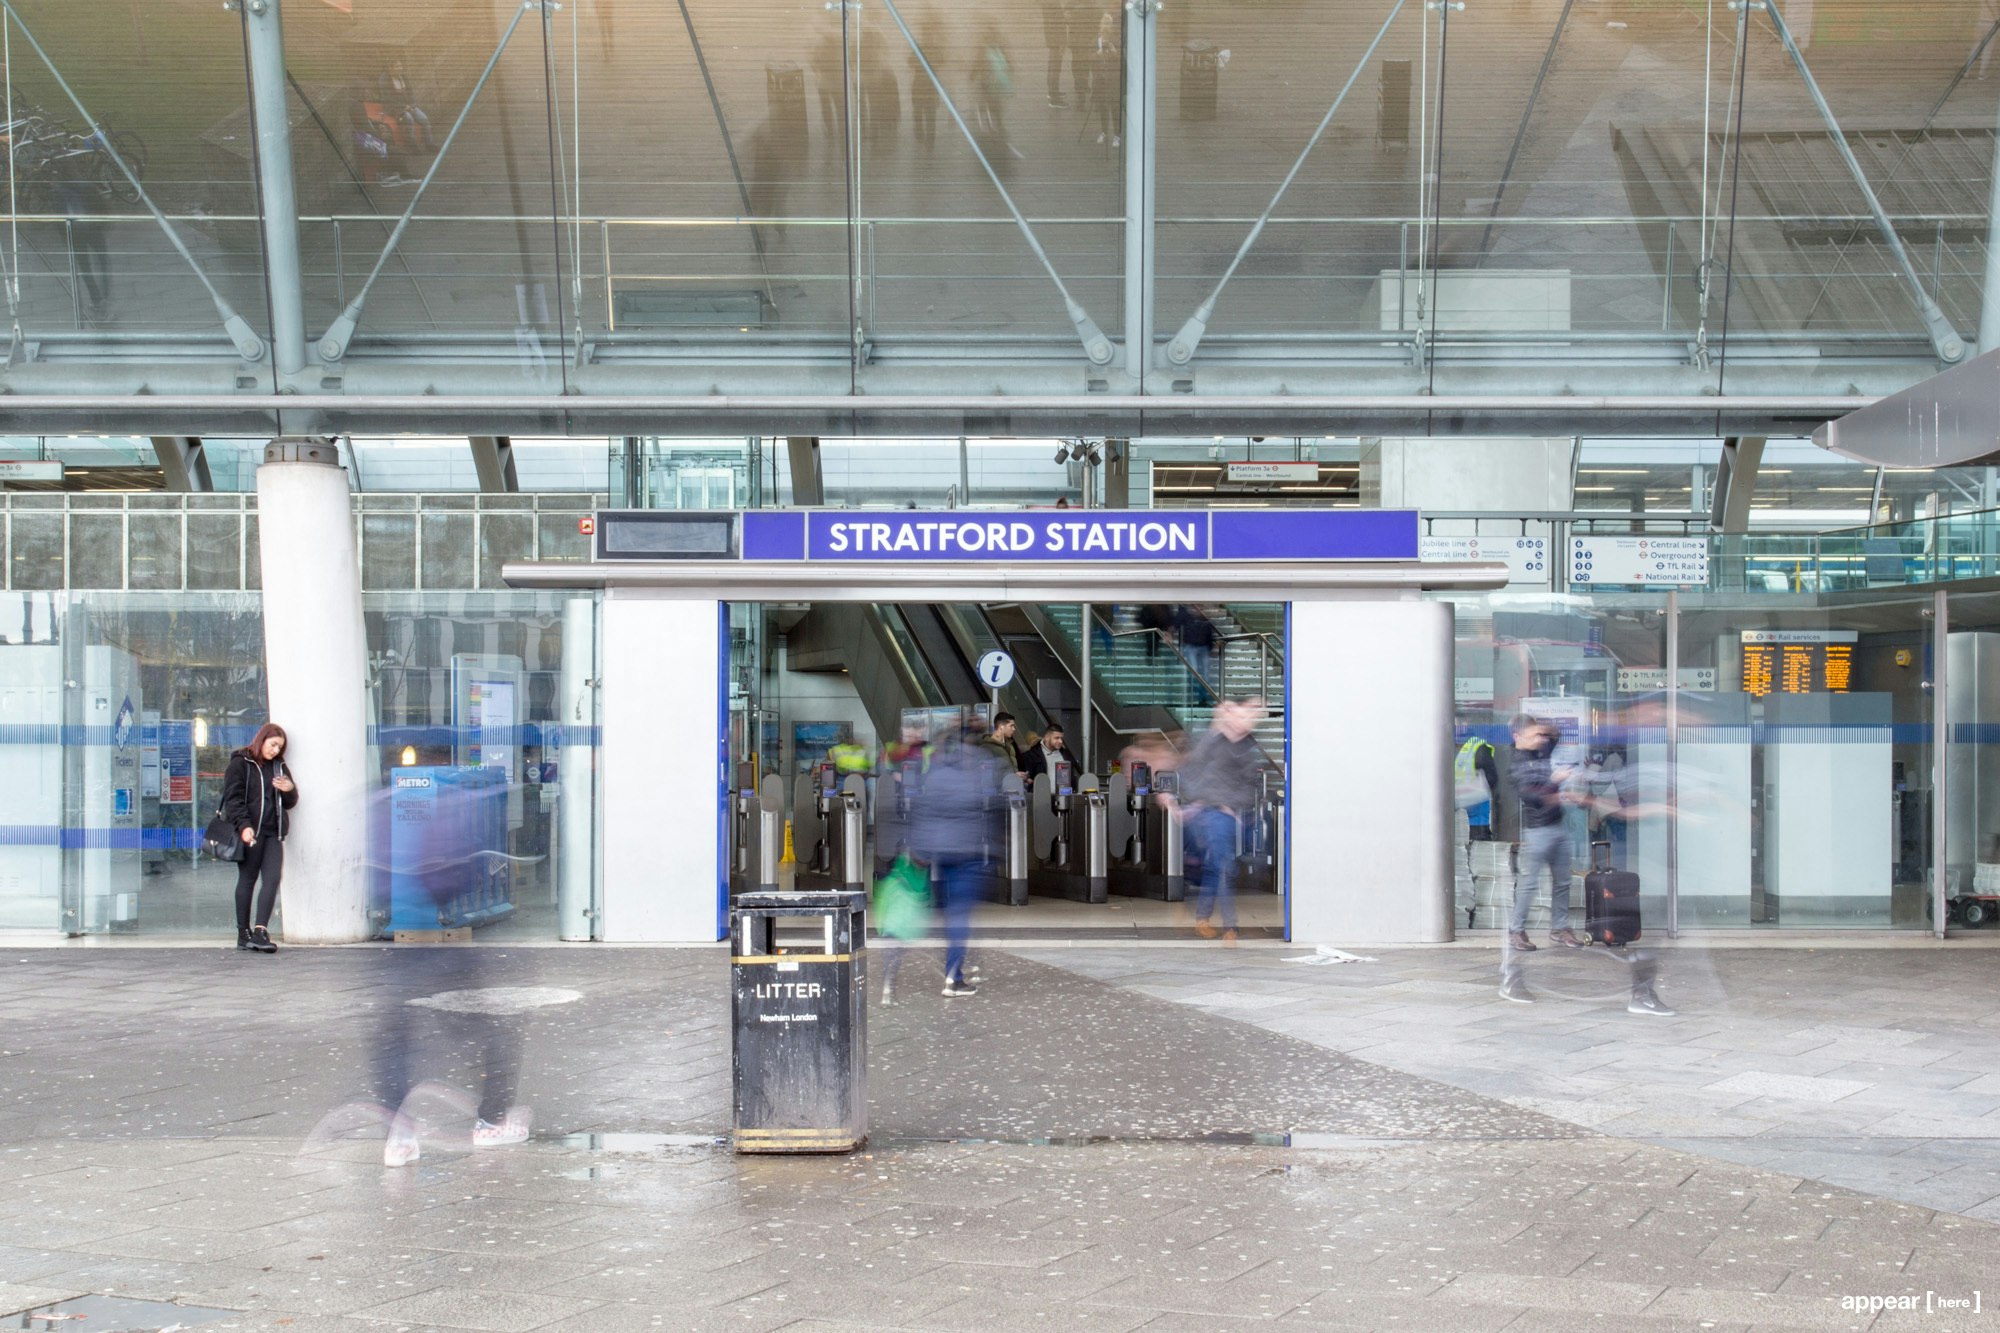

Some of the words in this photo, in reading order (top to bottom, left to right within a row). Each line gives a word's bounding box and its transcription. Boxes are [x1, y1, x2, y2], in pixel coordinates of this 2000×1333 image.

[829, 522, 1035, 552] STRATFORD
[1045, 522, 1195, 552] STATION
[1421, 539, 1449, 547] Jubilee
[1452, 539, 1466, 547] line
[1650, 552, 1696, 560] Overground
[398, 778, 430, 787] METRO
[756, 982, 821, 998] LITTER
[760, 1014, 790, 1022] Newham
